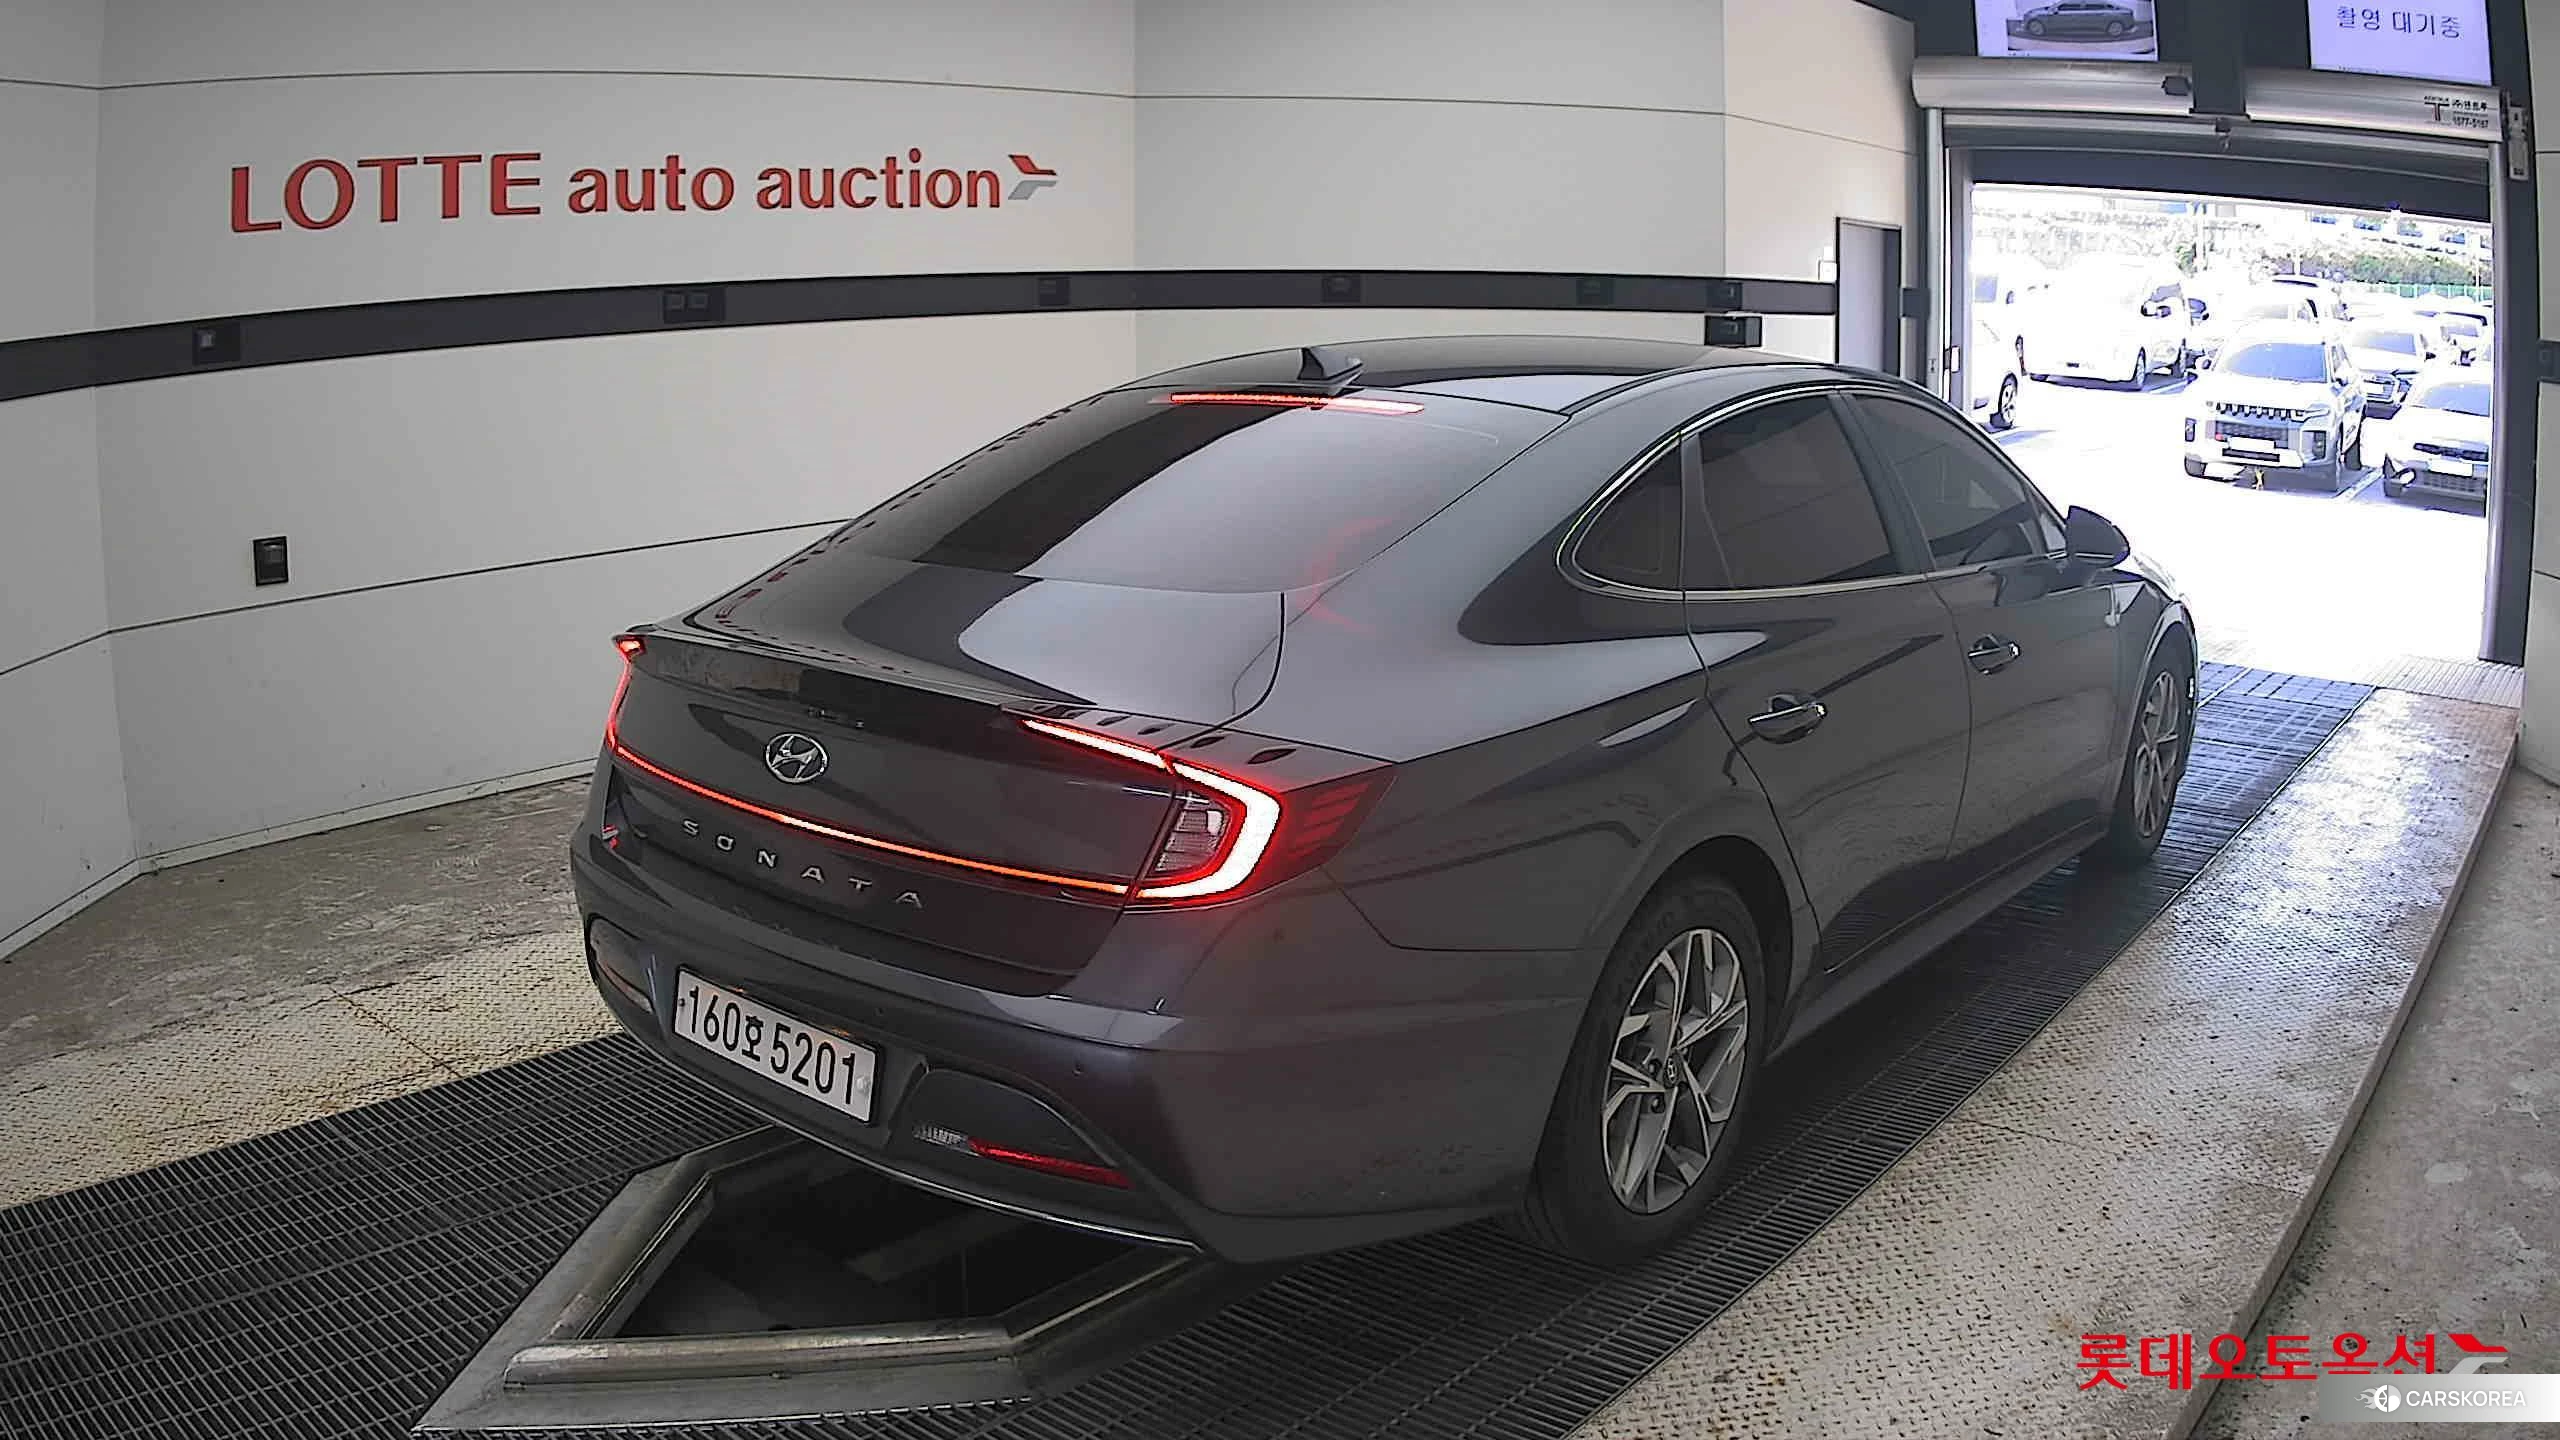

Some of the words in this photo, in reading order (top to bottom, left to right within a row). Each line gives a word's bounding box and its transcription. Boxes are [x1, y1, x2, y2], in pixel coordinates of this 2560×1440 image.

[2337, 6, 2380, 31] 촬영
[229, 151, 542, 233] LOTTE
[567, 153, 735, 214] auto
[756, 147, 1002, 210] auction
[682, 818, 923, 909] SONATA
[688, 985, 857, 1106] 160호5201
